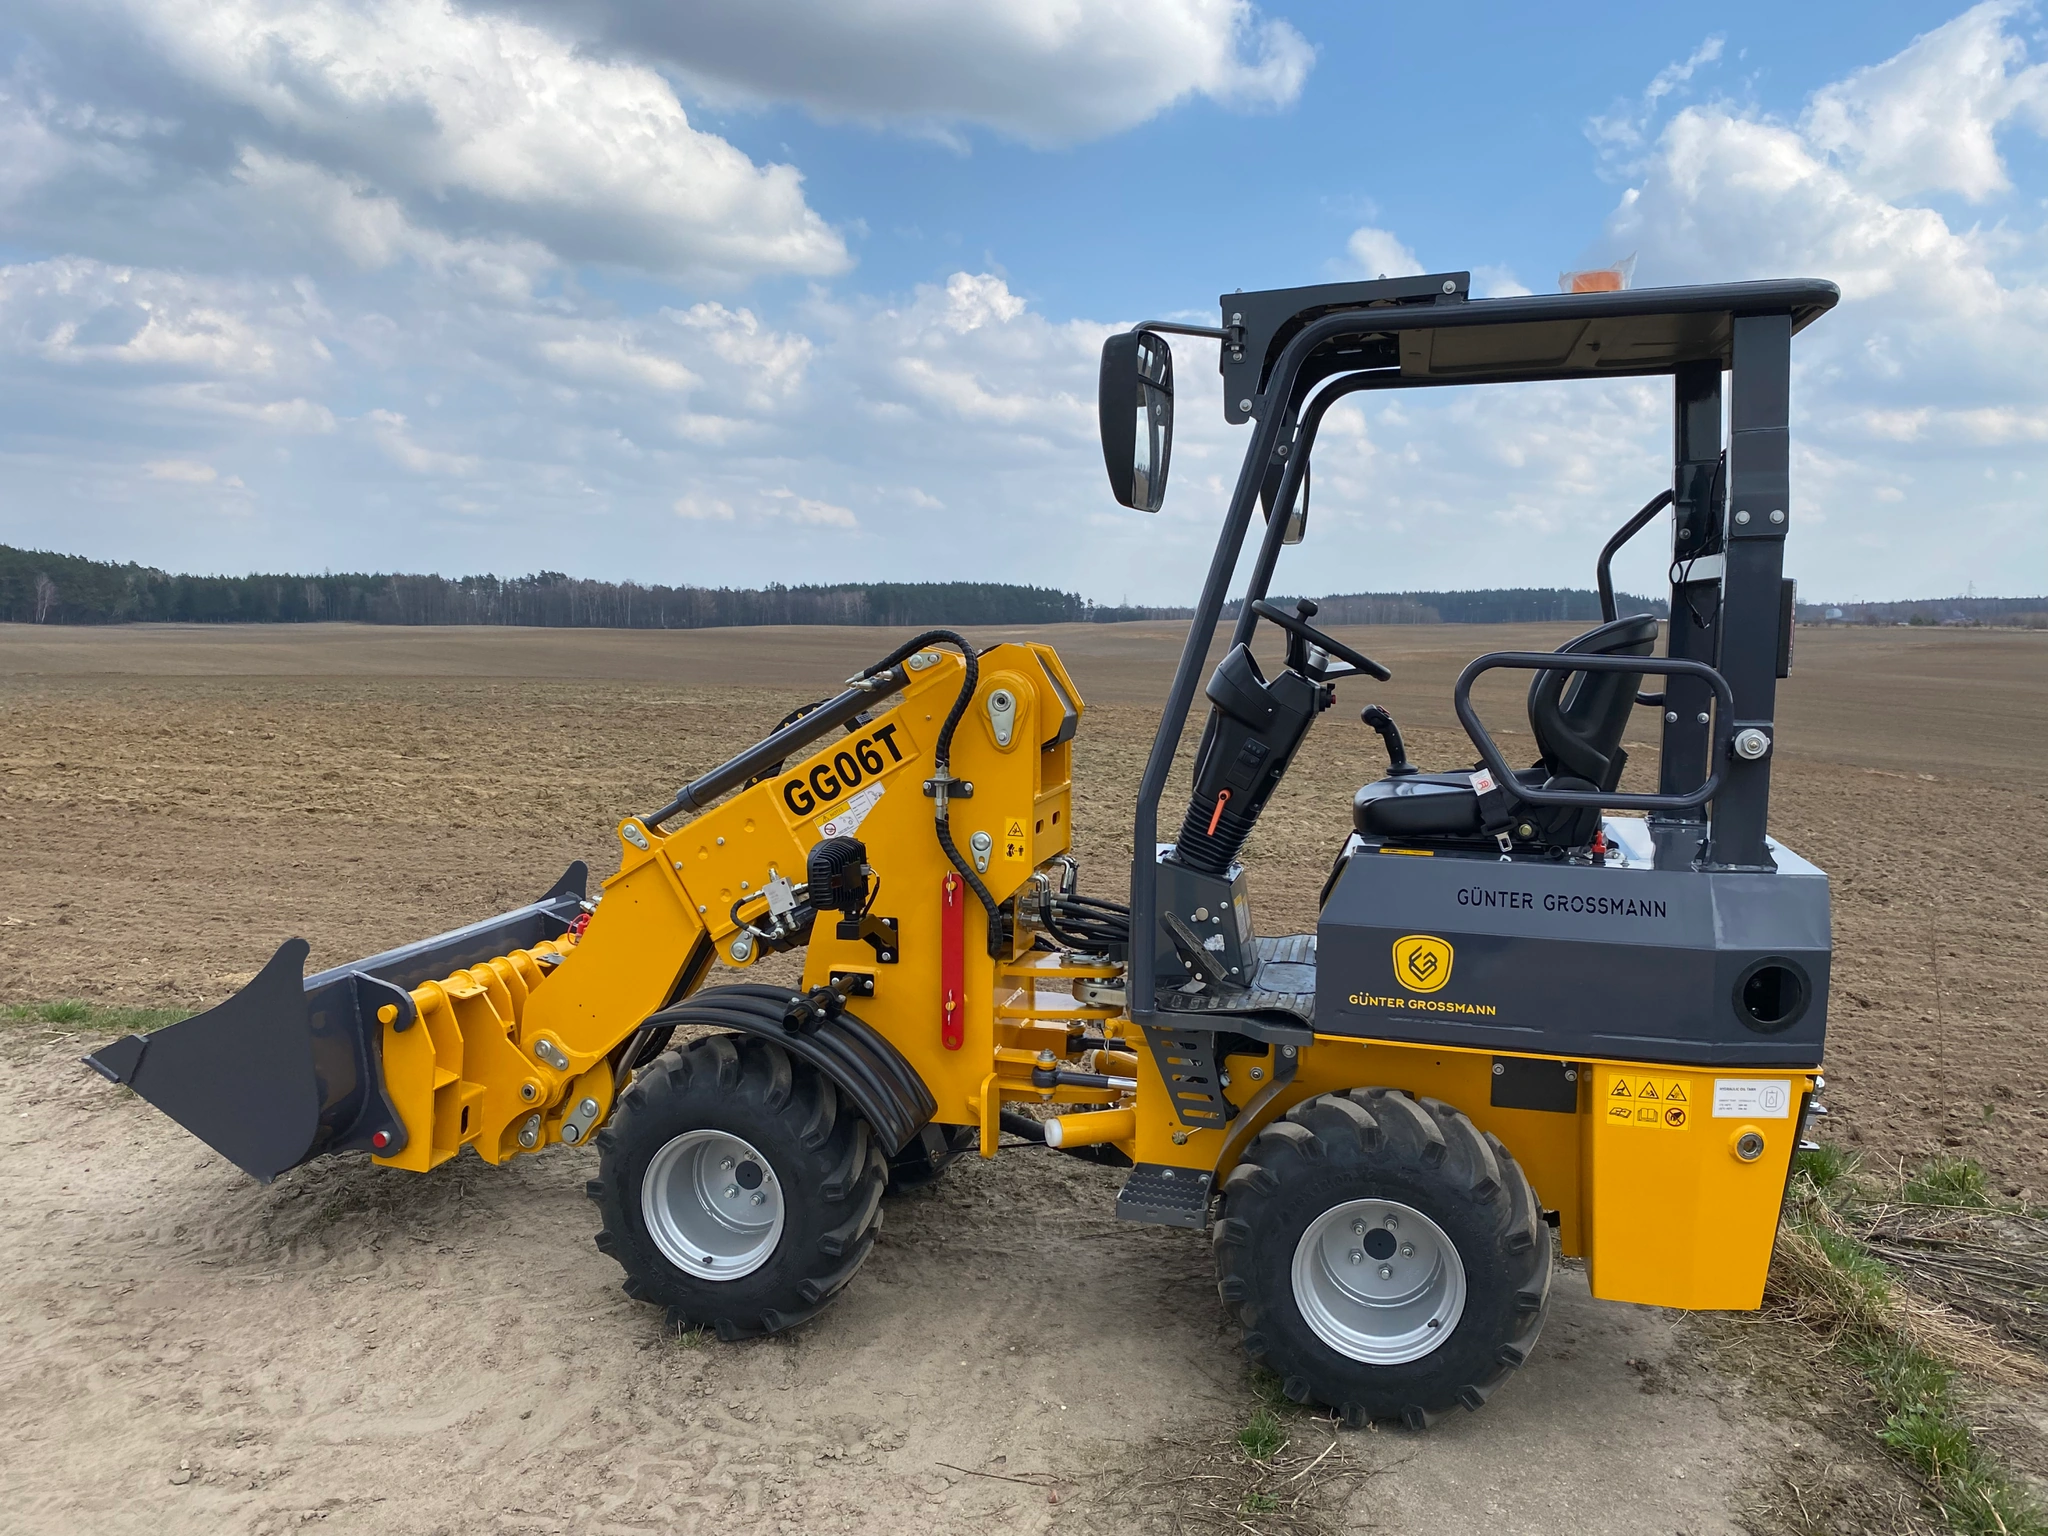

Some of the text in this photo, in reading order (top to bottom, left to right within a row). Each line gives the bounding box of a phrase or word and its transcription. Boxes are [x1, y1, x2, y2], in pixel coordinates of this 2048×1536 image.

[783, 722, 903, 816] GG06T
[1457, 887, 1666, 918] GÜNTER GROSSMANN
[1349, 992, 1496, 1016] GÜNTER GROSSMANN
